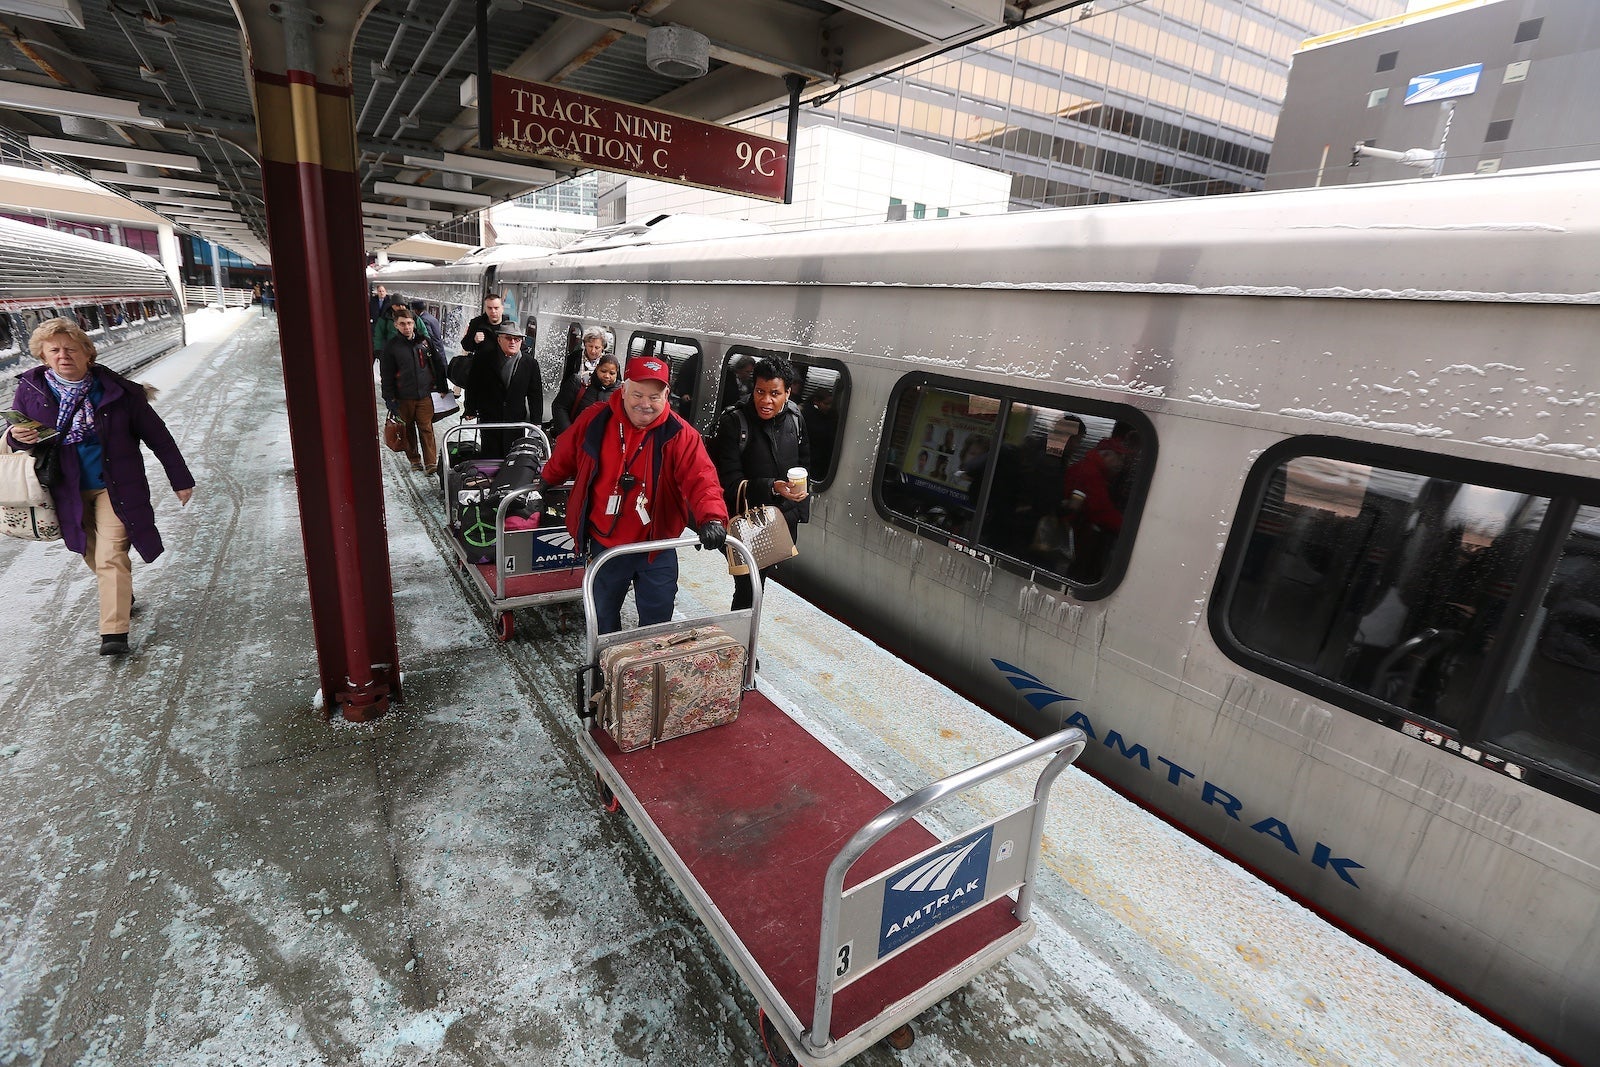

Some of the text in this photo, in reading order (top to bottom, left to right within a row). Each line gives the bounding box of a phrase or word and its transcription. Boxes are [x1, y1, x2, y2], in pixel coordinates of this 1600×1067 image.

[511, 88, 673, 144] TRACK NINE
[511, 119, 669, 169] LOCATION C
[736, 141, 776, 177] 9C
[506, 557, 514, 571] 4
[536, 553, 583, 562] AMTR
[1064, 711, 1366, 890] AMTRAK
[886, 878, 980, 938] AMTRAK
[837, 945, 850, 976] 3
